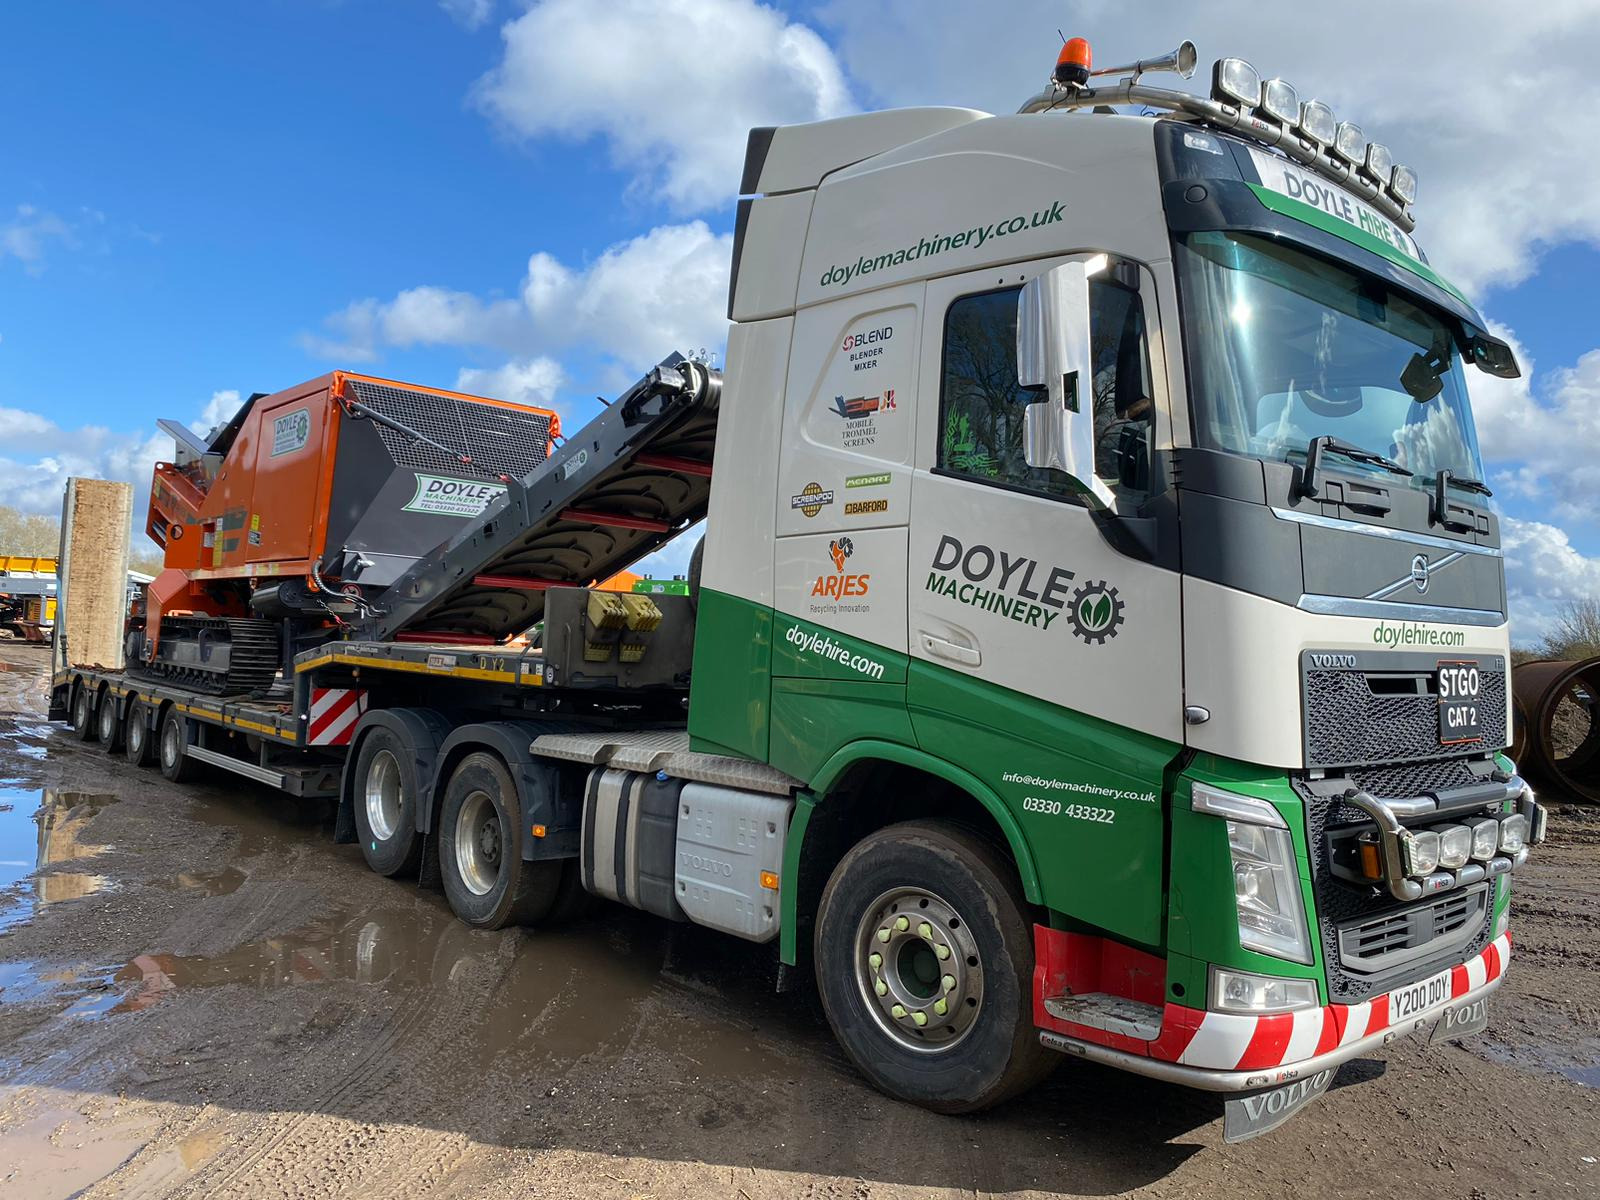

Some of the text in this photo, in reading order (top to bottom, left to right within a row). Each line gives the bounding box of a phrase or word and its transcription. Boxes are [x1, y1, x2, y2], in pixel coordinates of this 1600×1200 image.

[1284, 171, 1394, 245] DOYLE HIRE
[820, 201, 1066, 286] doylemachinery.co.uk
[849, 347, 884, 361] BLENDER
[854, 360, 878, 371] MIXER
[276, 415, 298, 435] DOYLE
[842, 427, 878, 439] TROMMEL
[846, 419, 874, 430] MOBILE
[843, 437, 875, 448] SCREENS
[423, 493, 482, 505] MACHINERY
[427, 480, 490, 498] DOYLE
[792, 491, 833, 505] SCREENPOD
[852, 500, 888, 513] BARFORD
[931, 535, 1075, 609] DOYLE
[811, 574, 870, 602] ARJES
[809, 604, 870, 614] Recycling Innovation
[925, 572, 1059, 630] MACHINERY
[1373, 621, 1465, 649] doylehire.com
[785, 624, 885, 679] doylehire.com
[1310, 654, 1356, 667] VOLVO
[1439, 668, 1479, 697] STGO
[1447, 707, 1477, 728] CAT 2
[1002, 772, 1157, 803] info@doylemachinery.co.uk
[1022, 797, 1115, 824] 03330 433322
[680, 852, 733, 877] VOLVO
[1395, 975, 1448, 1018] Y200 DOY
[1240, 1069, 1330, 1121] VOLVO
